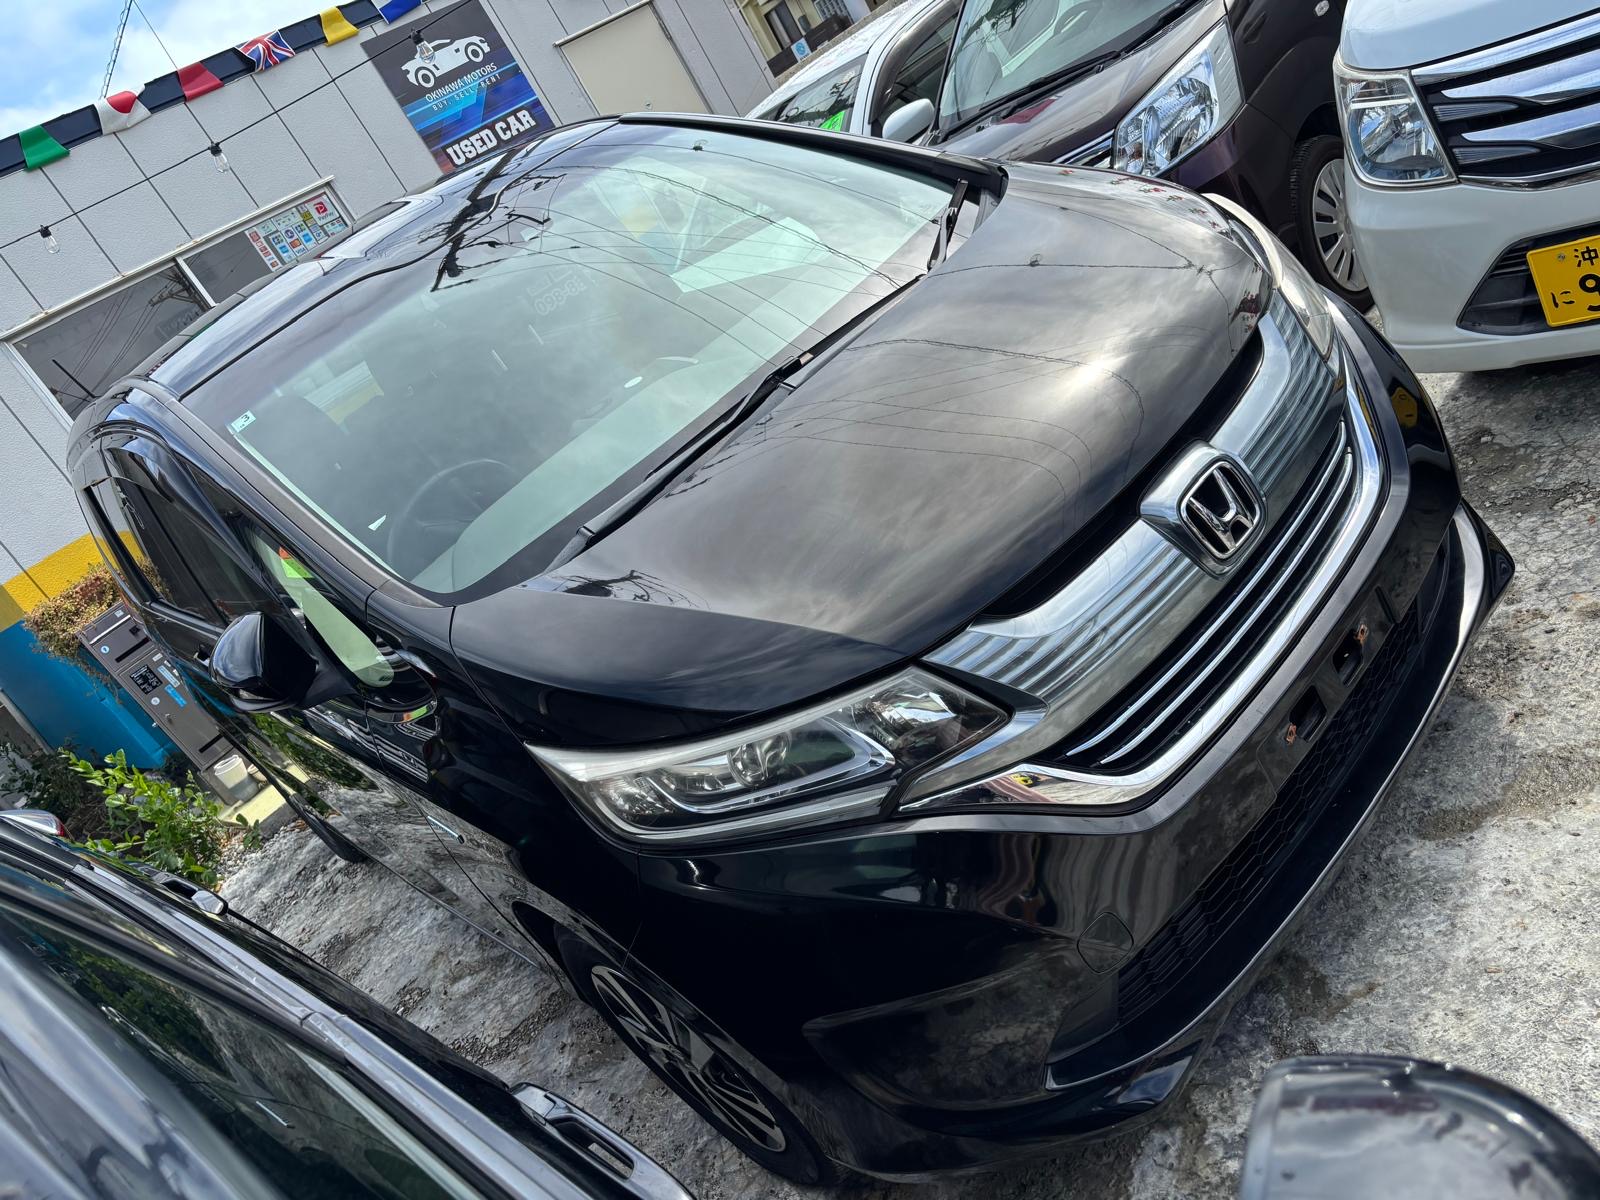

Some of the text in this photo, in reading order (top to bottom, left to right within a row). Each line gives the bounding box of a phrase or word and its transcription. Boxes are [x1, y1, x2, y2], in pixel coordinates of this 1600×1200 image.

[425, 62, 498, 103] OKINAWA MOTORS
[480, 73, 501, 88] RENT
[446, 109, 537, 166] USED CAR
[1573, 245, 1599, 268] 沖
[1550, 290, 1576, 309] に
